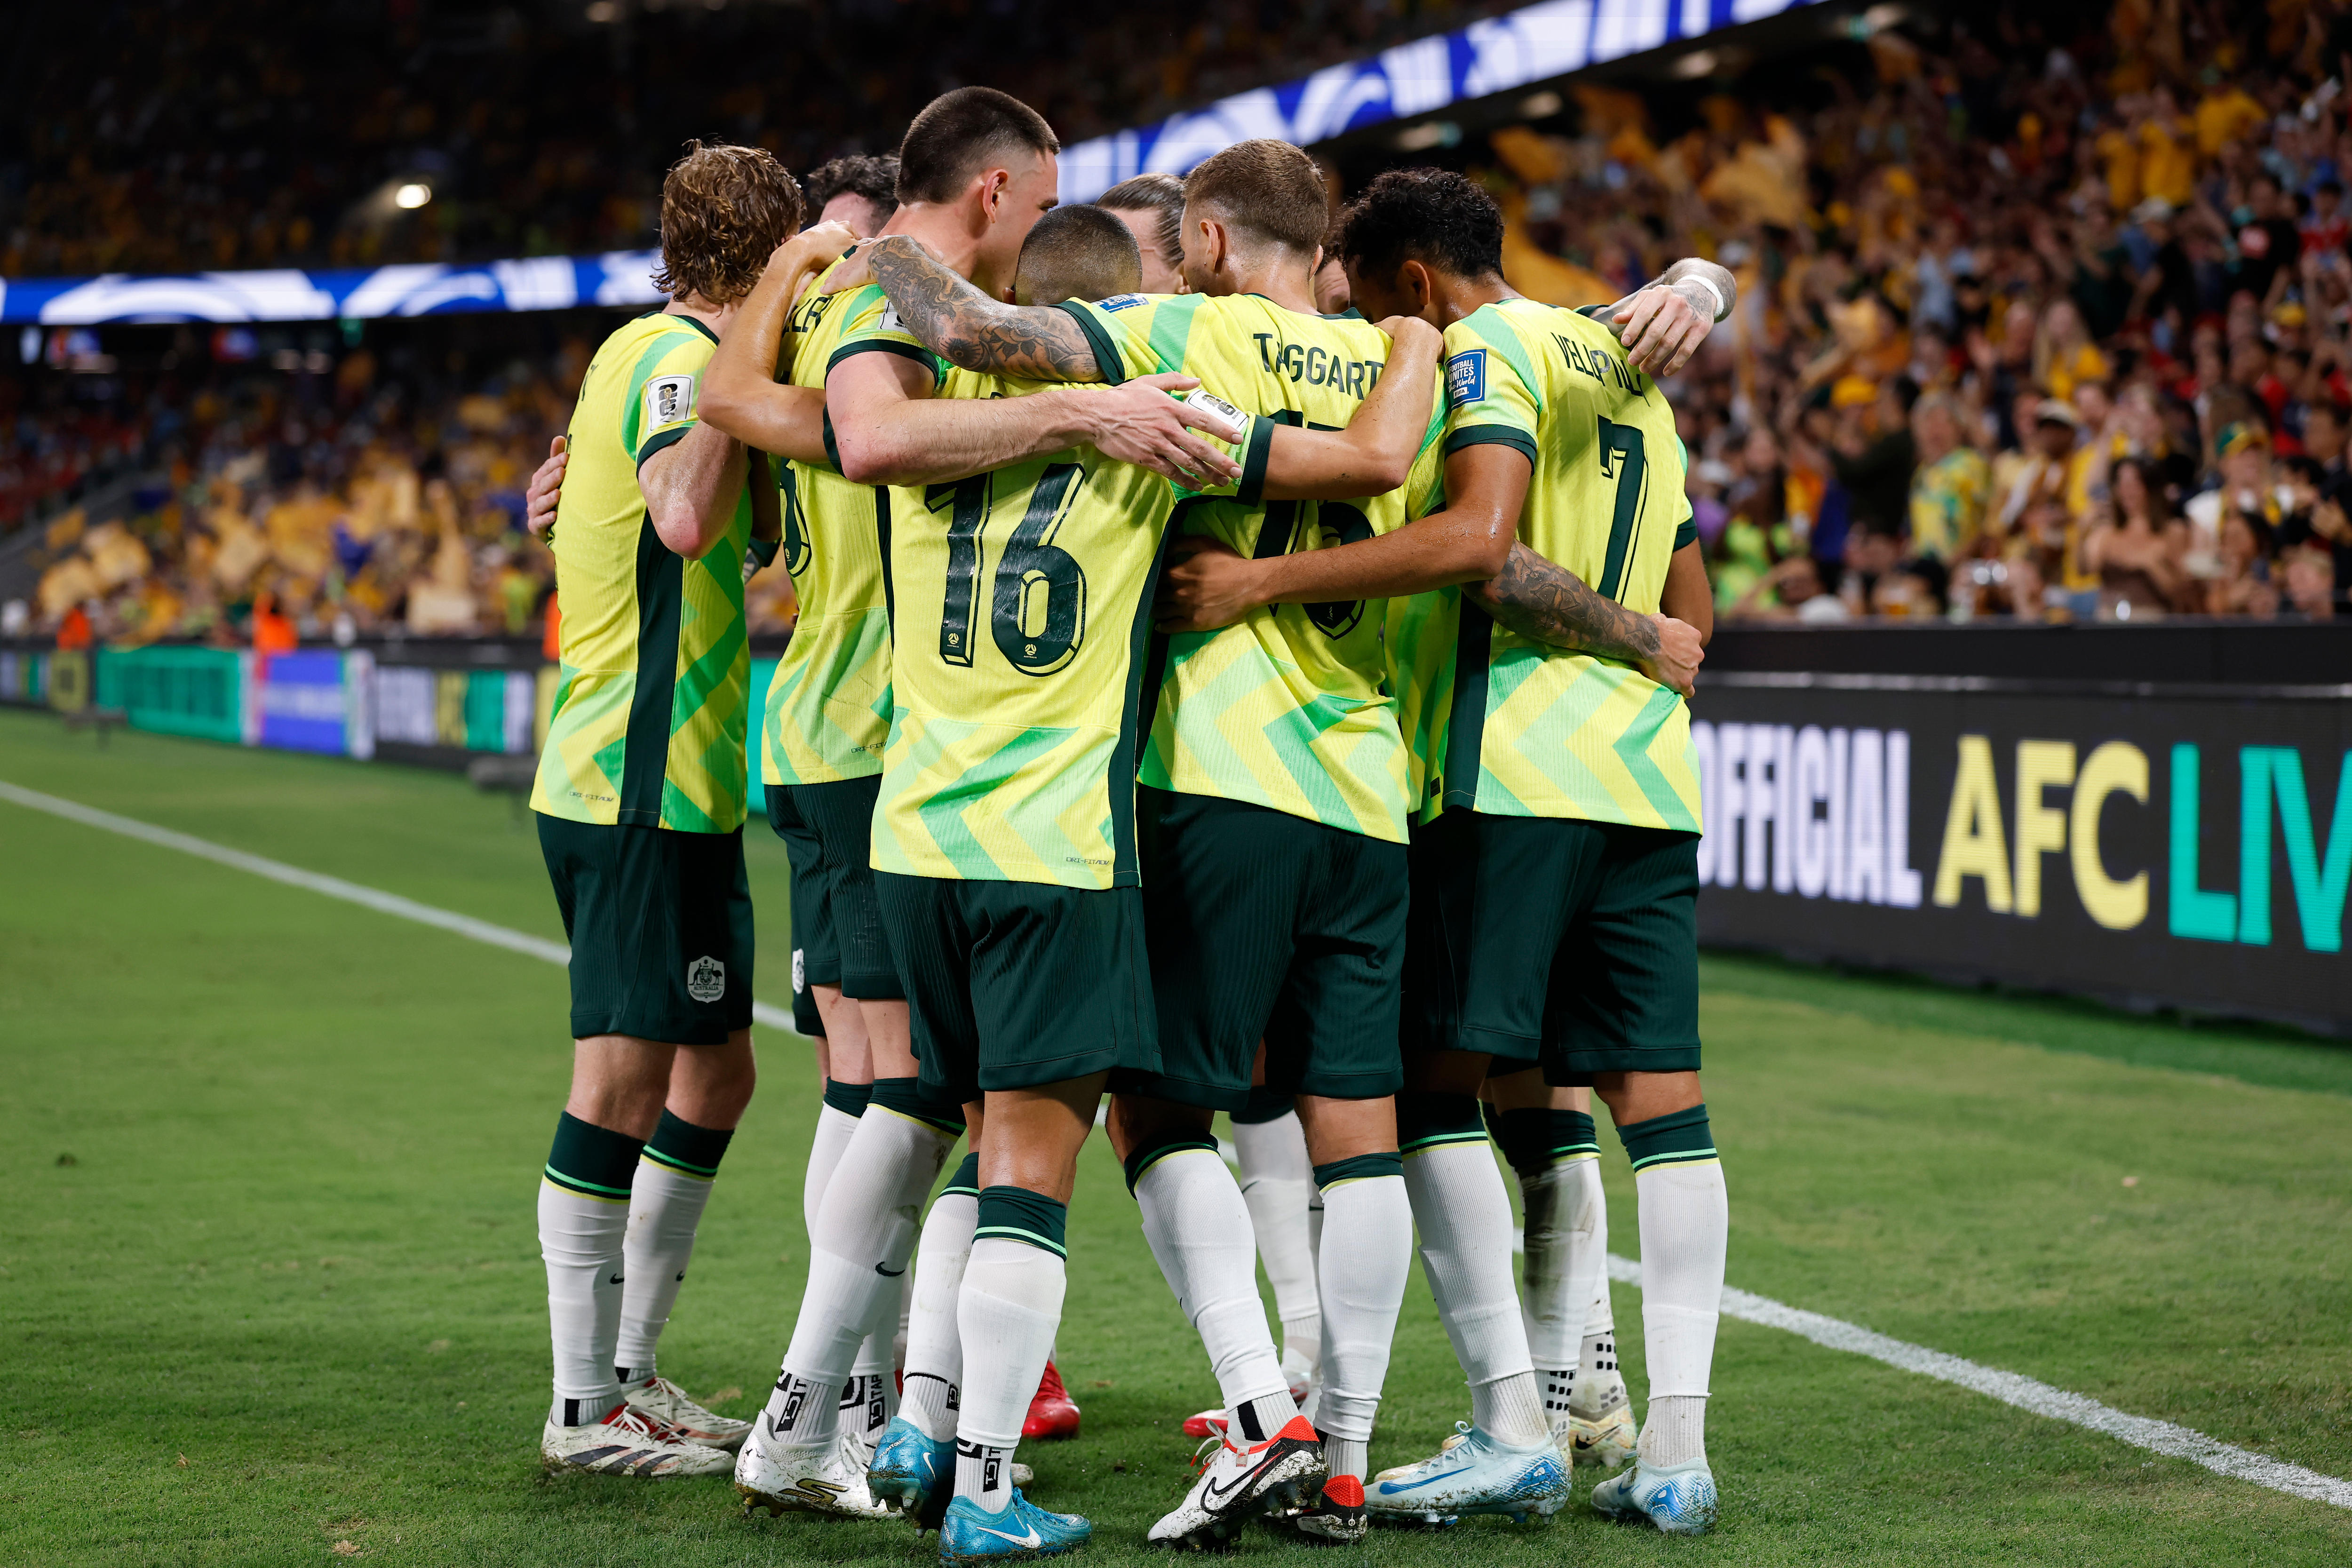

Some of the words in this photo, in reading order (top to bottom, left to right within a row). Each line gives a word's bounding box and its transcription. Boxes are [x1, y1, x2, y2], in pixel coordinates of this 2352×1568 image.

[1449, 359, 1474, 373] FOOTBALL
[1449, 366, 1474, 383] UNITES
[1456, 375, 1476, 388] World
[1597, 414, 1648, 606] 7
[925, 463, 1087, 677] 16
[1695, 720, 1922, 909] OFFICIAL
[1933, 734, 2150, 931] AFC
